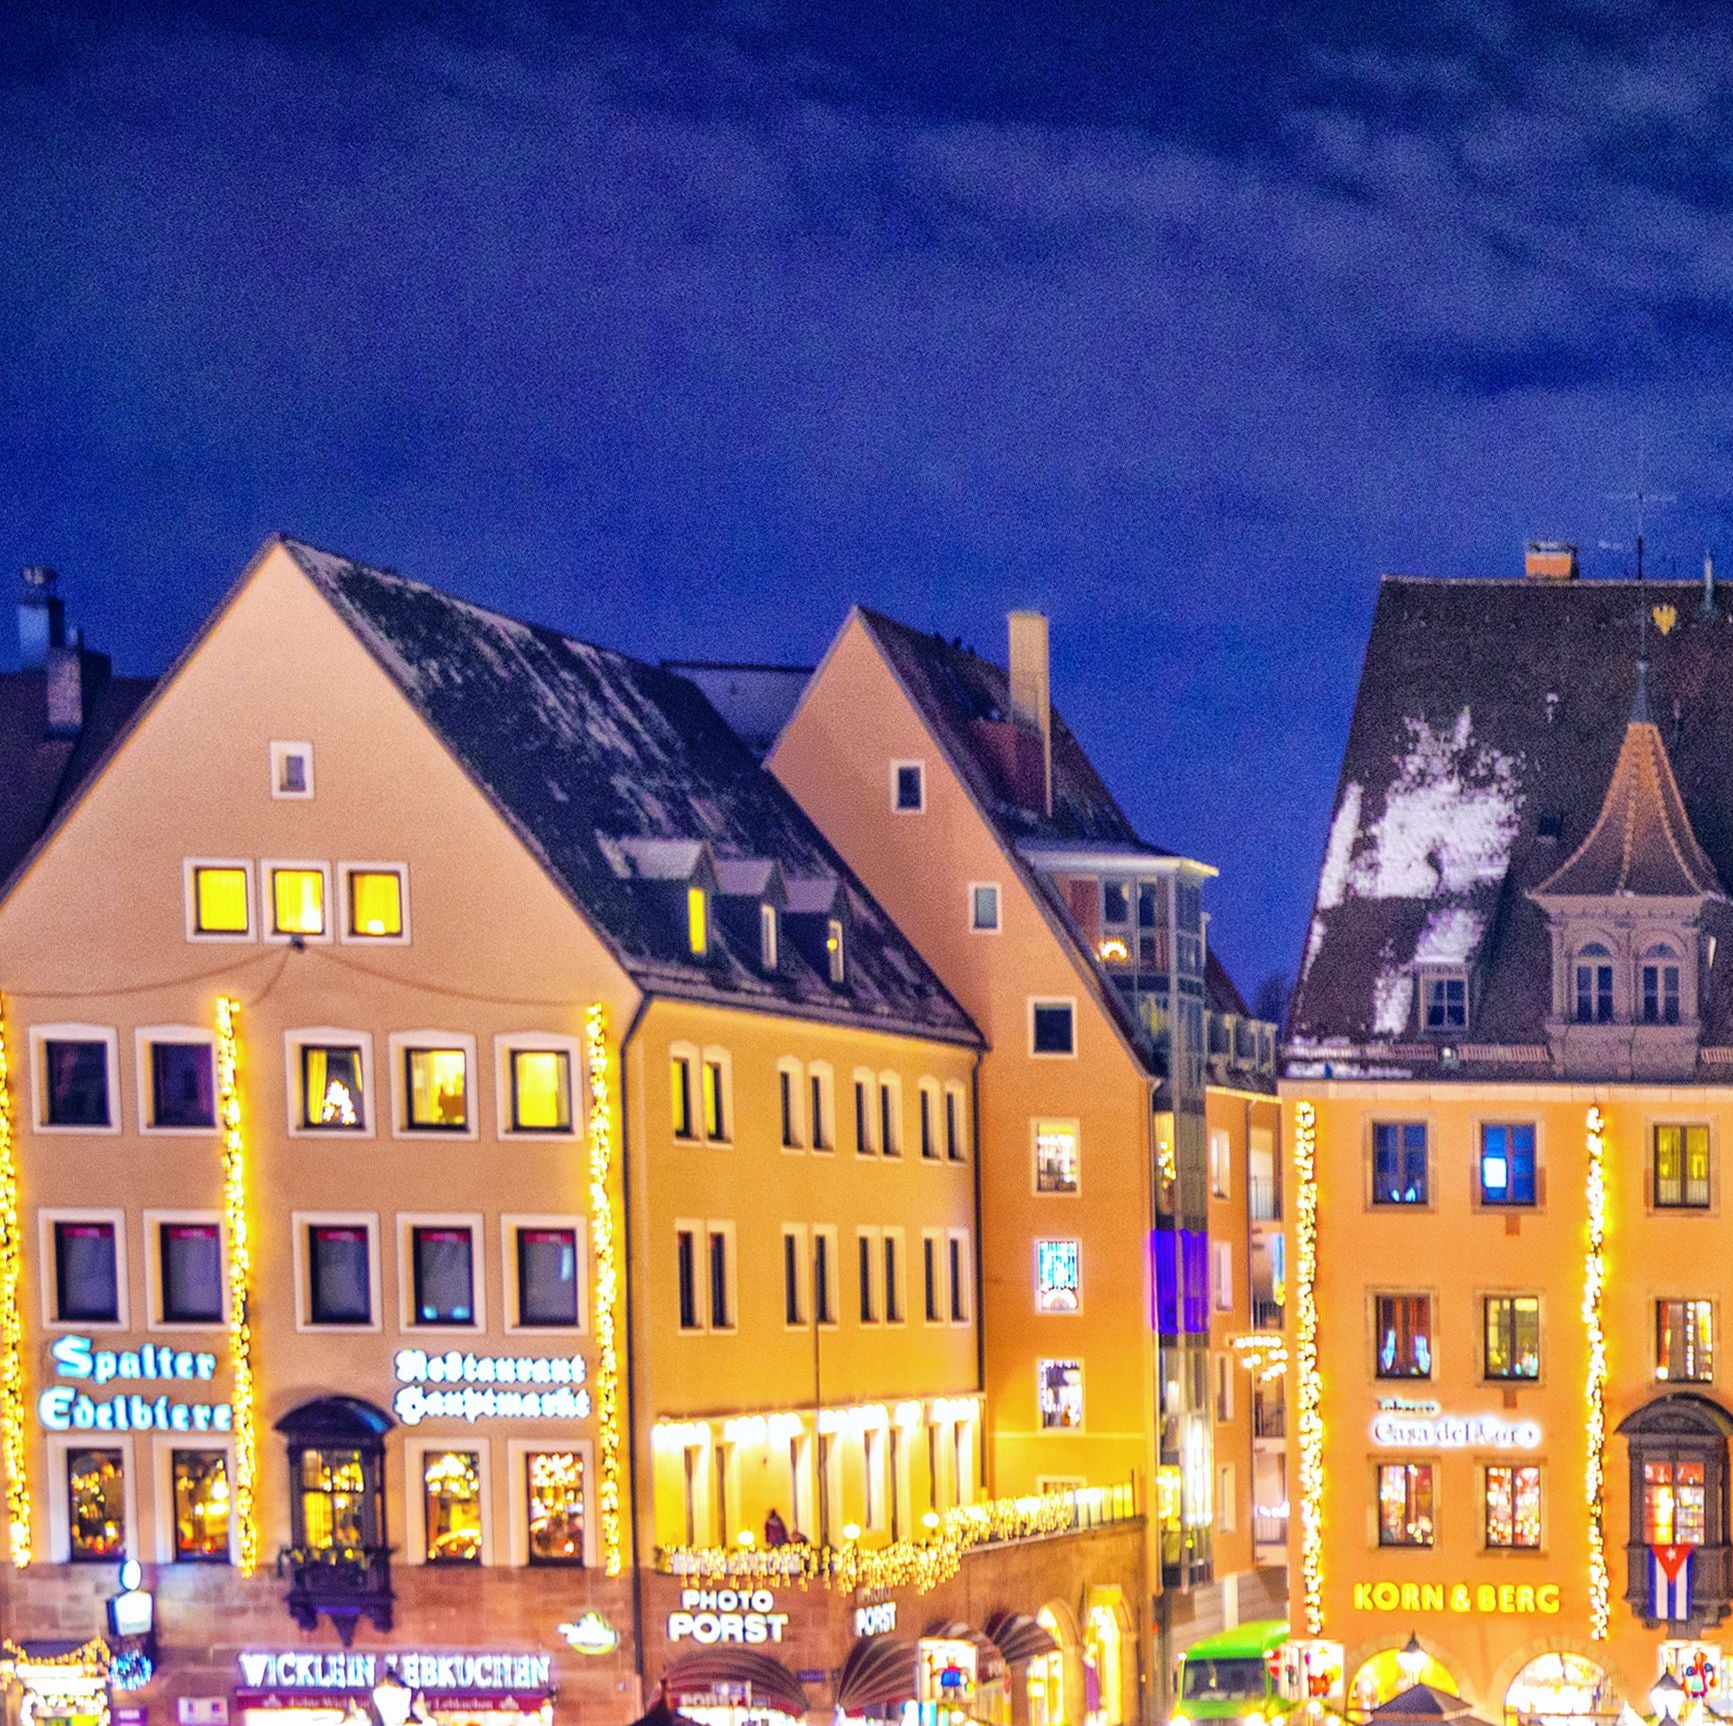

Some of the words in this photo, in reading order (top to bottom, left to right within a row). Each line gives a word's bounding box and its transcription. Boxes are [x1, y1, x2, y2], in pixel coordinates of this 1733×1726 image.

[53, 1335, 217, 1384] Spalter
[39, 1386, 233, 1431] Edelbiere
[682, 1588, 774, 1613] PHOTO
[1353, 1582, 1444, 1611] KORN
[1450, 1583, 1471, 1613] &
[1477, 1584, 1560, 1614] BERG
[667, 1613, 789, 1643] PORST
[855, 1600, 897, 1638] PORST
[238, 1653, 376, 1689] WICKLEIN
